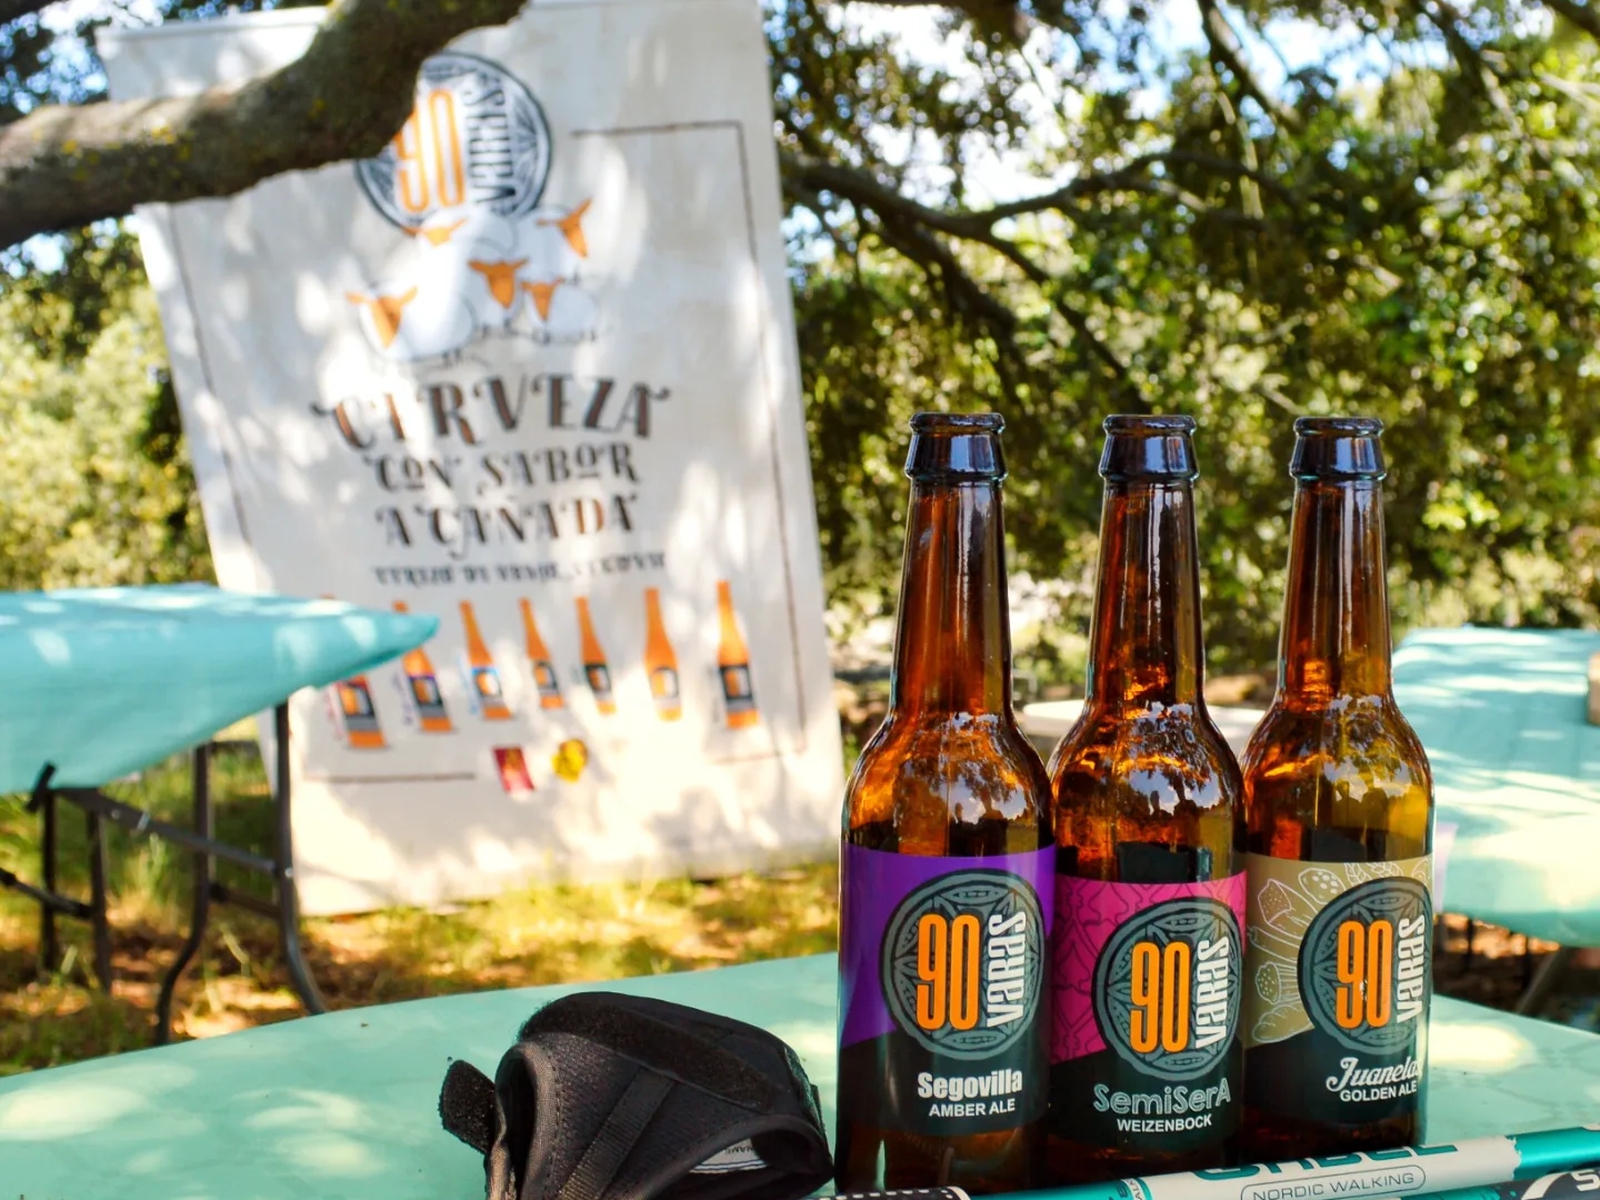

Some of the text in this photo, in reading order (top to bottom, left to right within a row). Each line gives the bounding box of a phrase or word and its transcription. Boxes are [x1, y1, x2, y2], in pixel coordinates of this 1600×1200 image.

[916, 913, 980, 1031] 90
[1336, 919, 1393, 1029] 90
[1130, 941, 1190, 1054] 90
[917, 1068, 1023, 1102] Segovilla
[1340, 1080, 1417, 1102] GOLDEN ALE
[928, 1097, 1016, 1118] AMBER ALE
[1116, 1113, 1213, 1133] WEIZENBOCK
[1252, 1172, 1415, 1200] NORDIC WALKING
